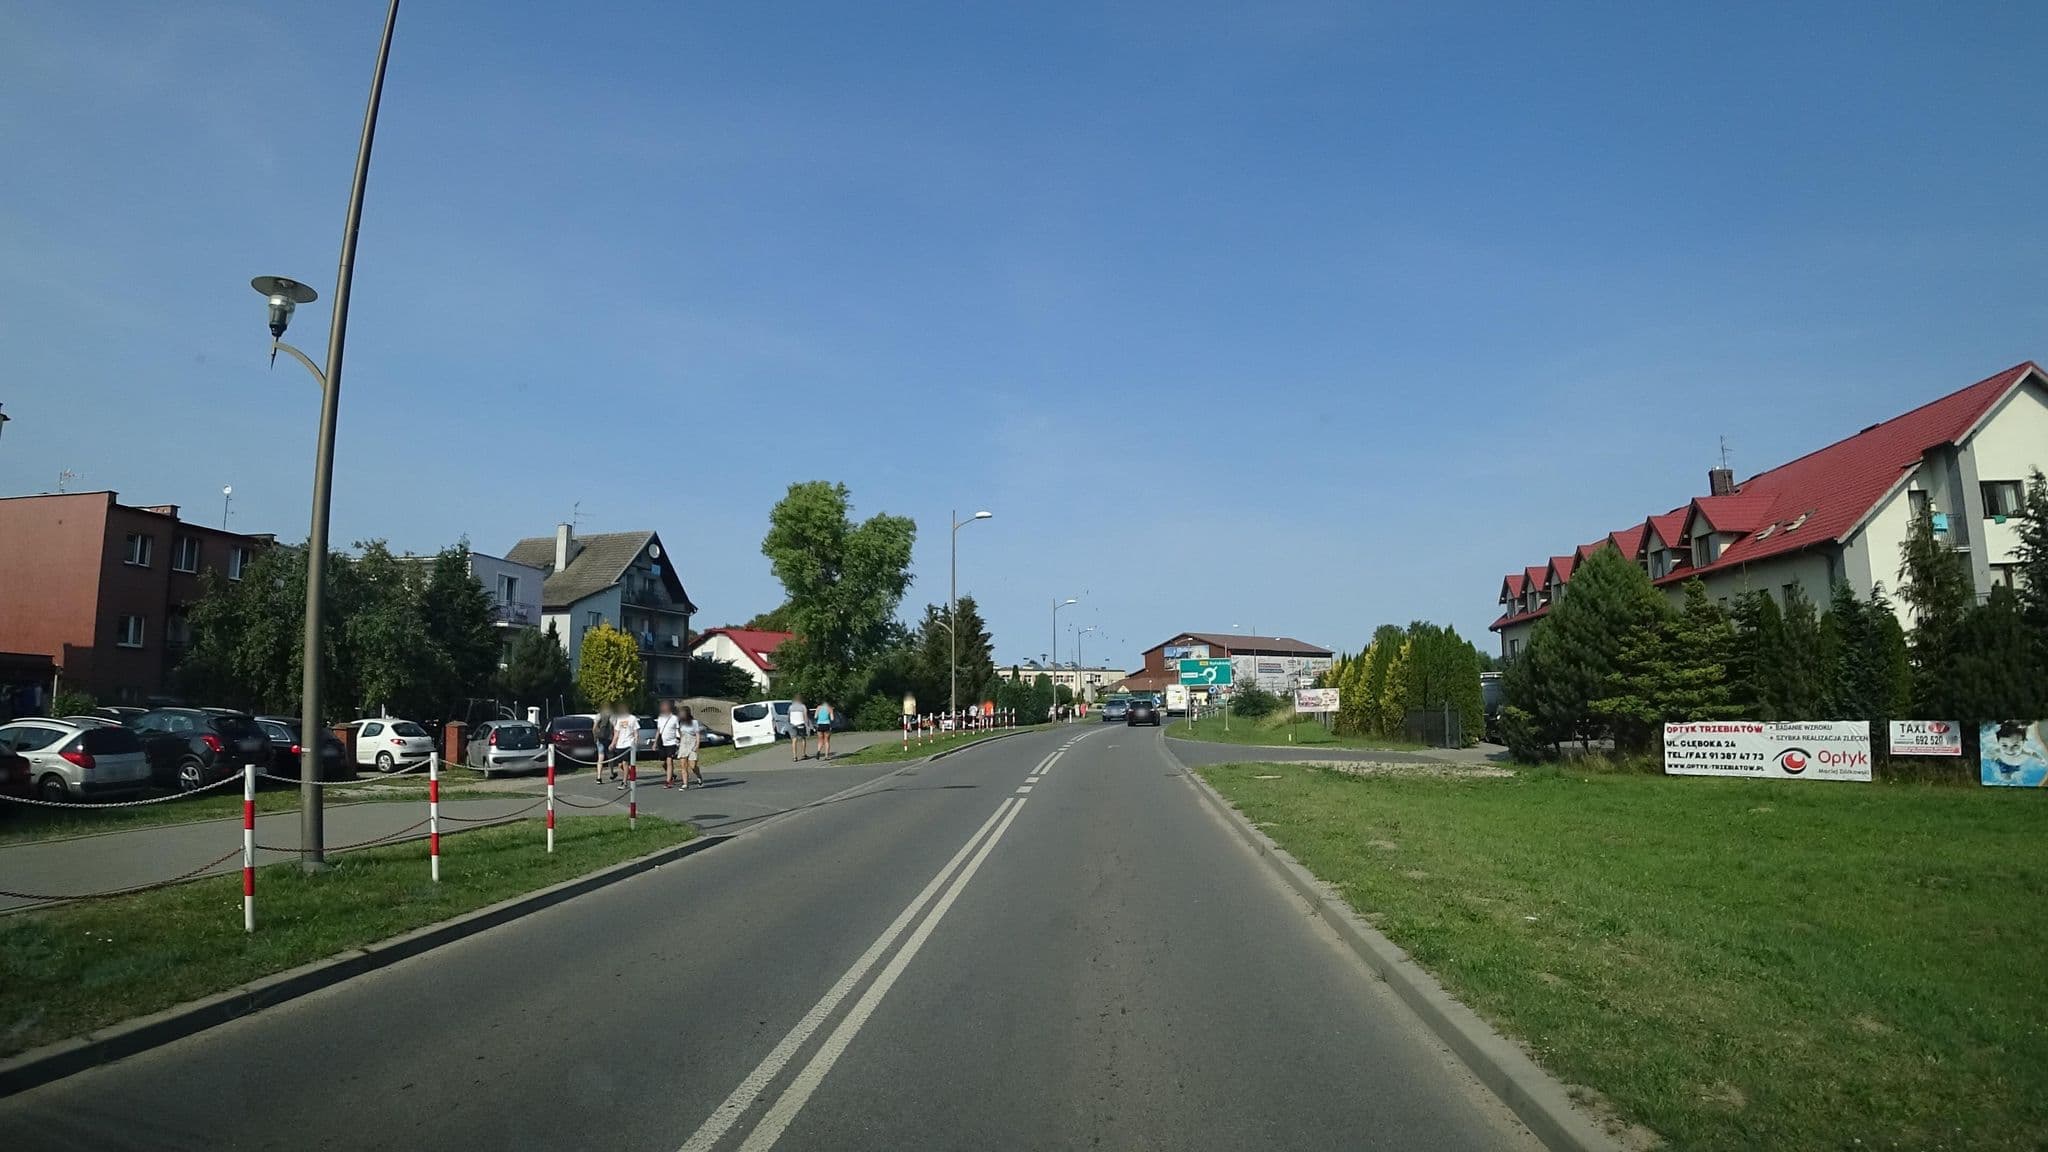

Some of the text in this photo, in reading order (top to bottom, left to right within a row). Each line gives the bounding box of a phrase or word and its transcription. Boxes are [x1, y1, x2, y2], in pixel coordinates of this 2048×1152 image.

[1699, 724, 1763, 733] TRZEBIATÓW
[1899, 723, 1926, 734] TAXI
[1666, 740, 1736, 748] UL. GŁĘBOKA 24
[1667, 751, 1707, 759] TEL./FAX
[1720, 752, 1737, 760] 387
[1739, 752, 1750, 760] 47
[1752, 753, 1764, 761] 73
[1818, 750, 1868, 768] Optyk
